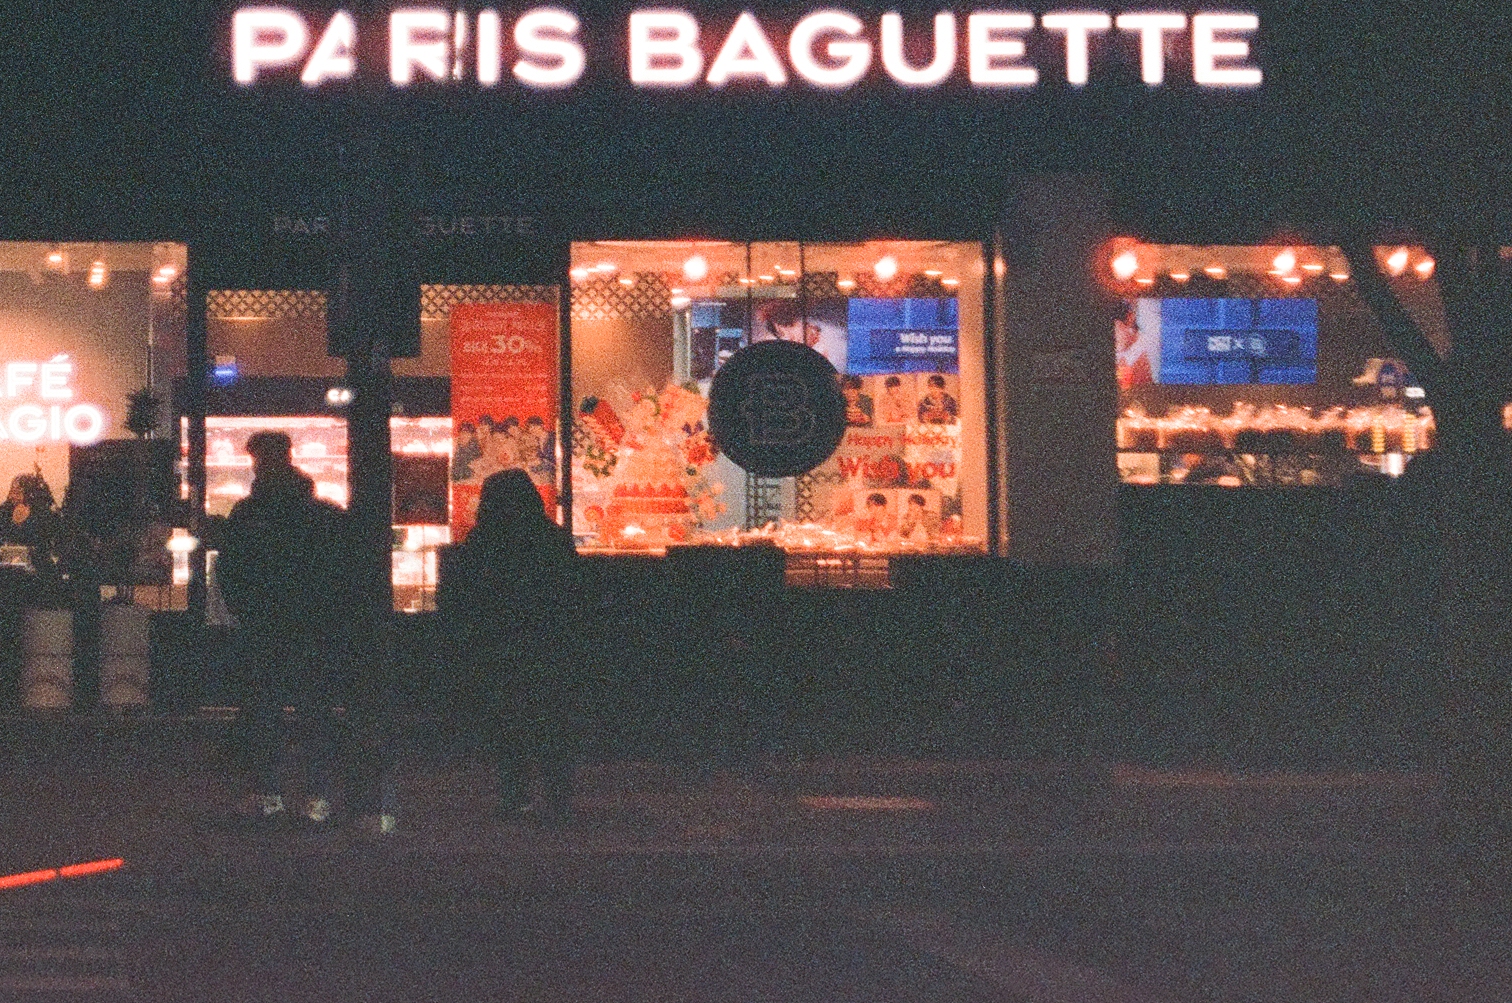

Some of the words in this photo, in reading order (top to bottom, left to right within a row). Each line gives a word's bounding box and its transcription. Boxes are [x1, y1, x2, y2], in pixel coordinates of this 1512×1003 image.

[231, 7, 585, 86] PARIS
[628, 9, 1263, 87] BAGUETTE
[273, 216, 330, 234] PAR
[836, 455, 899, 479] Wish
[905, 462, 956, 485] you
